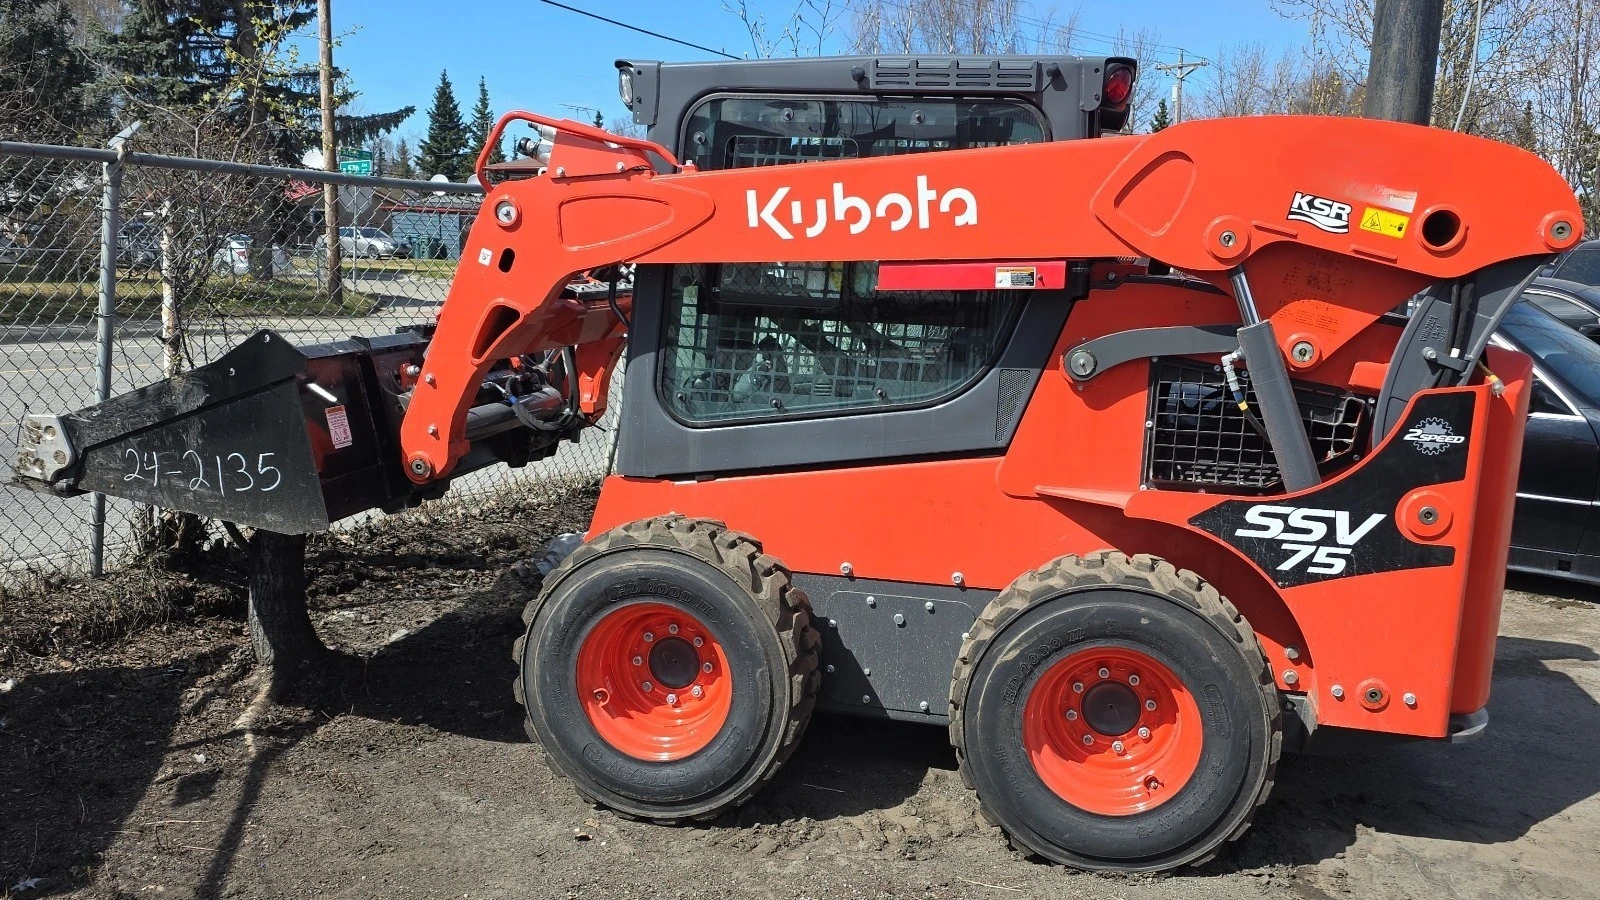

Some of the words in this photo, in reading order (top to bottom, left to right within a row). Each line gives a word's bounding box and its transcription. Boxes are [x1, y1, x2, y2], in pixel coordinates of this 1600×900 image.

[746, 174, 978, 240] Kubota
[1292, 191, 1353, 222] KSR
[123, 448, 281, 497] 24-2135
[1234, 504, 1388, 546] SSV
[1275, 543, 1353, 575] 75
